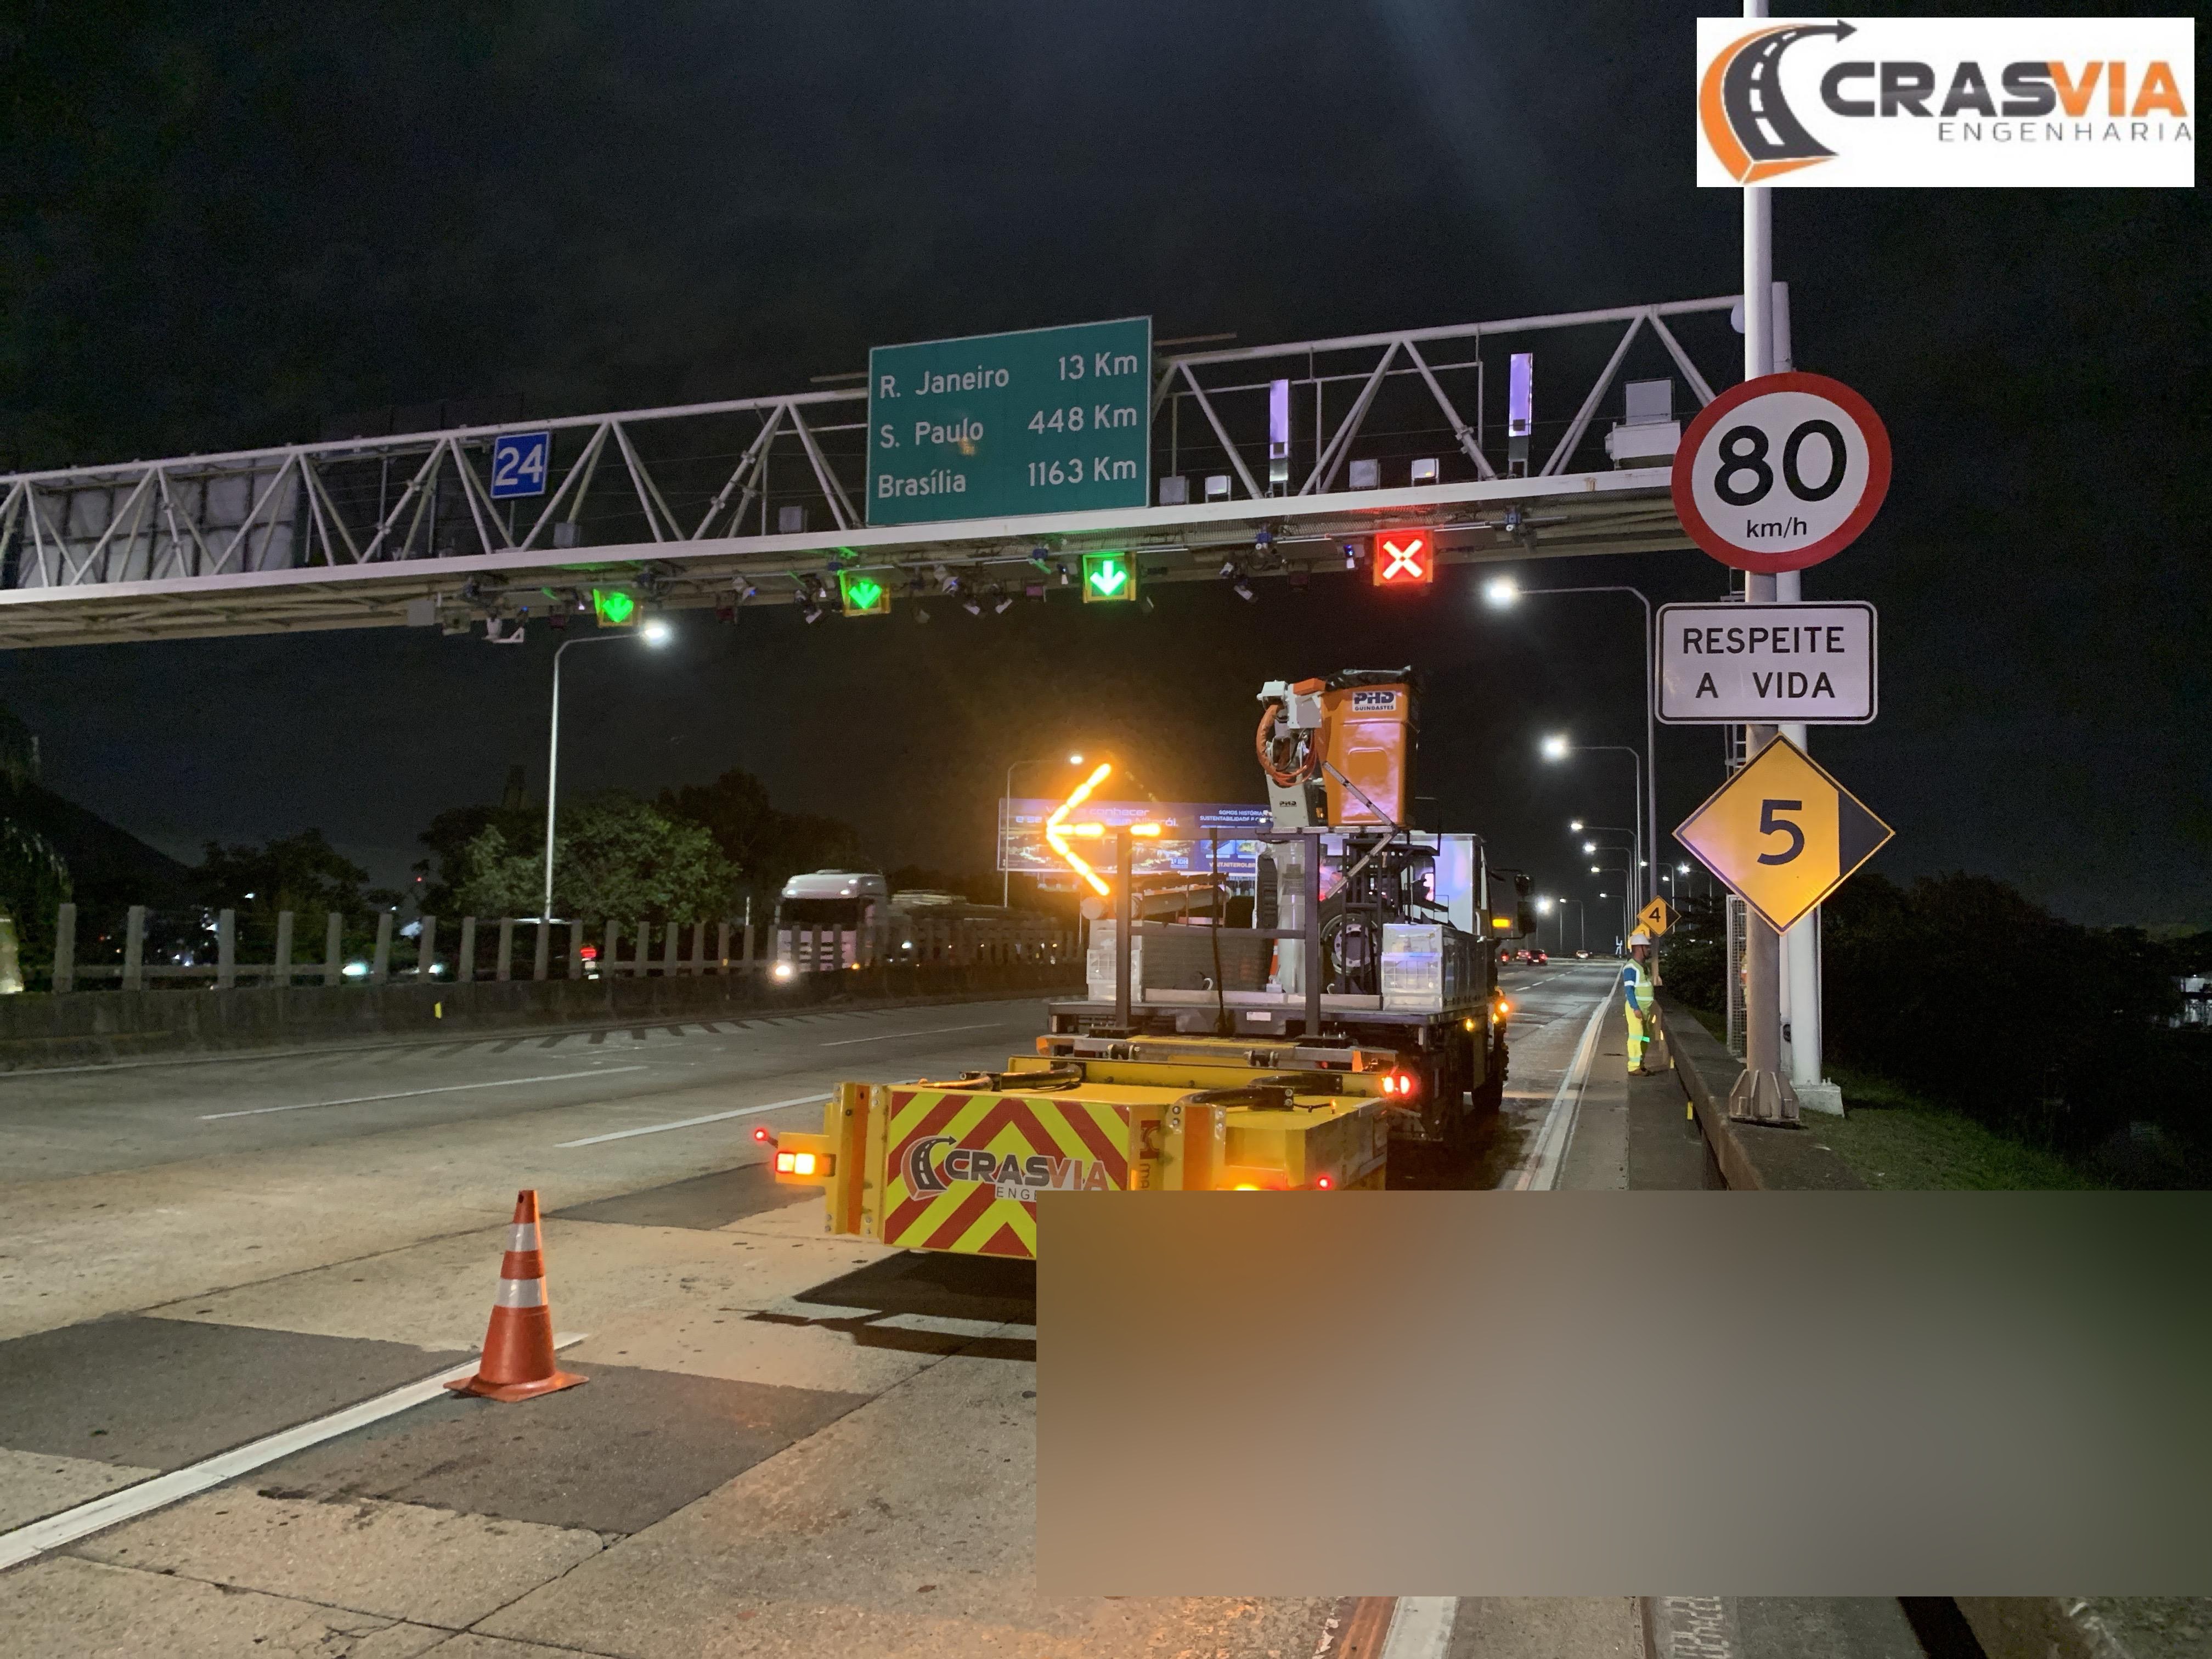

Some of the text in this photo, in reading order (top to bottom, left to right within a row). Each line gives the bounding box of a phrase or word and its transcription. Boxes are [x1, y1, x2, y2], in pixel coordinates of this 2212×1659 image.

[880, 352, 1137, 399] R. Janeiro 13 Km
[880, 404, 1137, 448] S. Paulo 448 Km
[495, 443, 543, 486] 24
[878, 456, 1137, 499] Brasília 1163 Km
[1714, 419, 1847, 506] 80
[1746, 516, 1807, 538] km/h
[1683, 626, 1845, 654] RESPEITE
[1355, 692, 1394, 704] PHD
[1695, 672, 1835, 698] A VIDA
[1090, 808, 1150, 816] conhecer
[1757, 799, 1805, 866] 5
[1649, 907, 1661, 923] 4
[944, 1150, 1109, 1190] CRASVIA
[1139, 1163, 1150, 1190] ma
